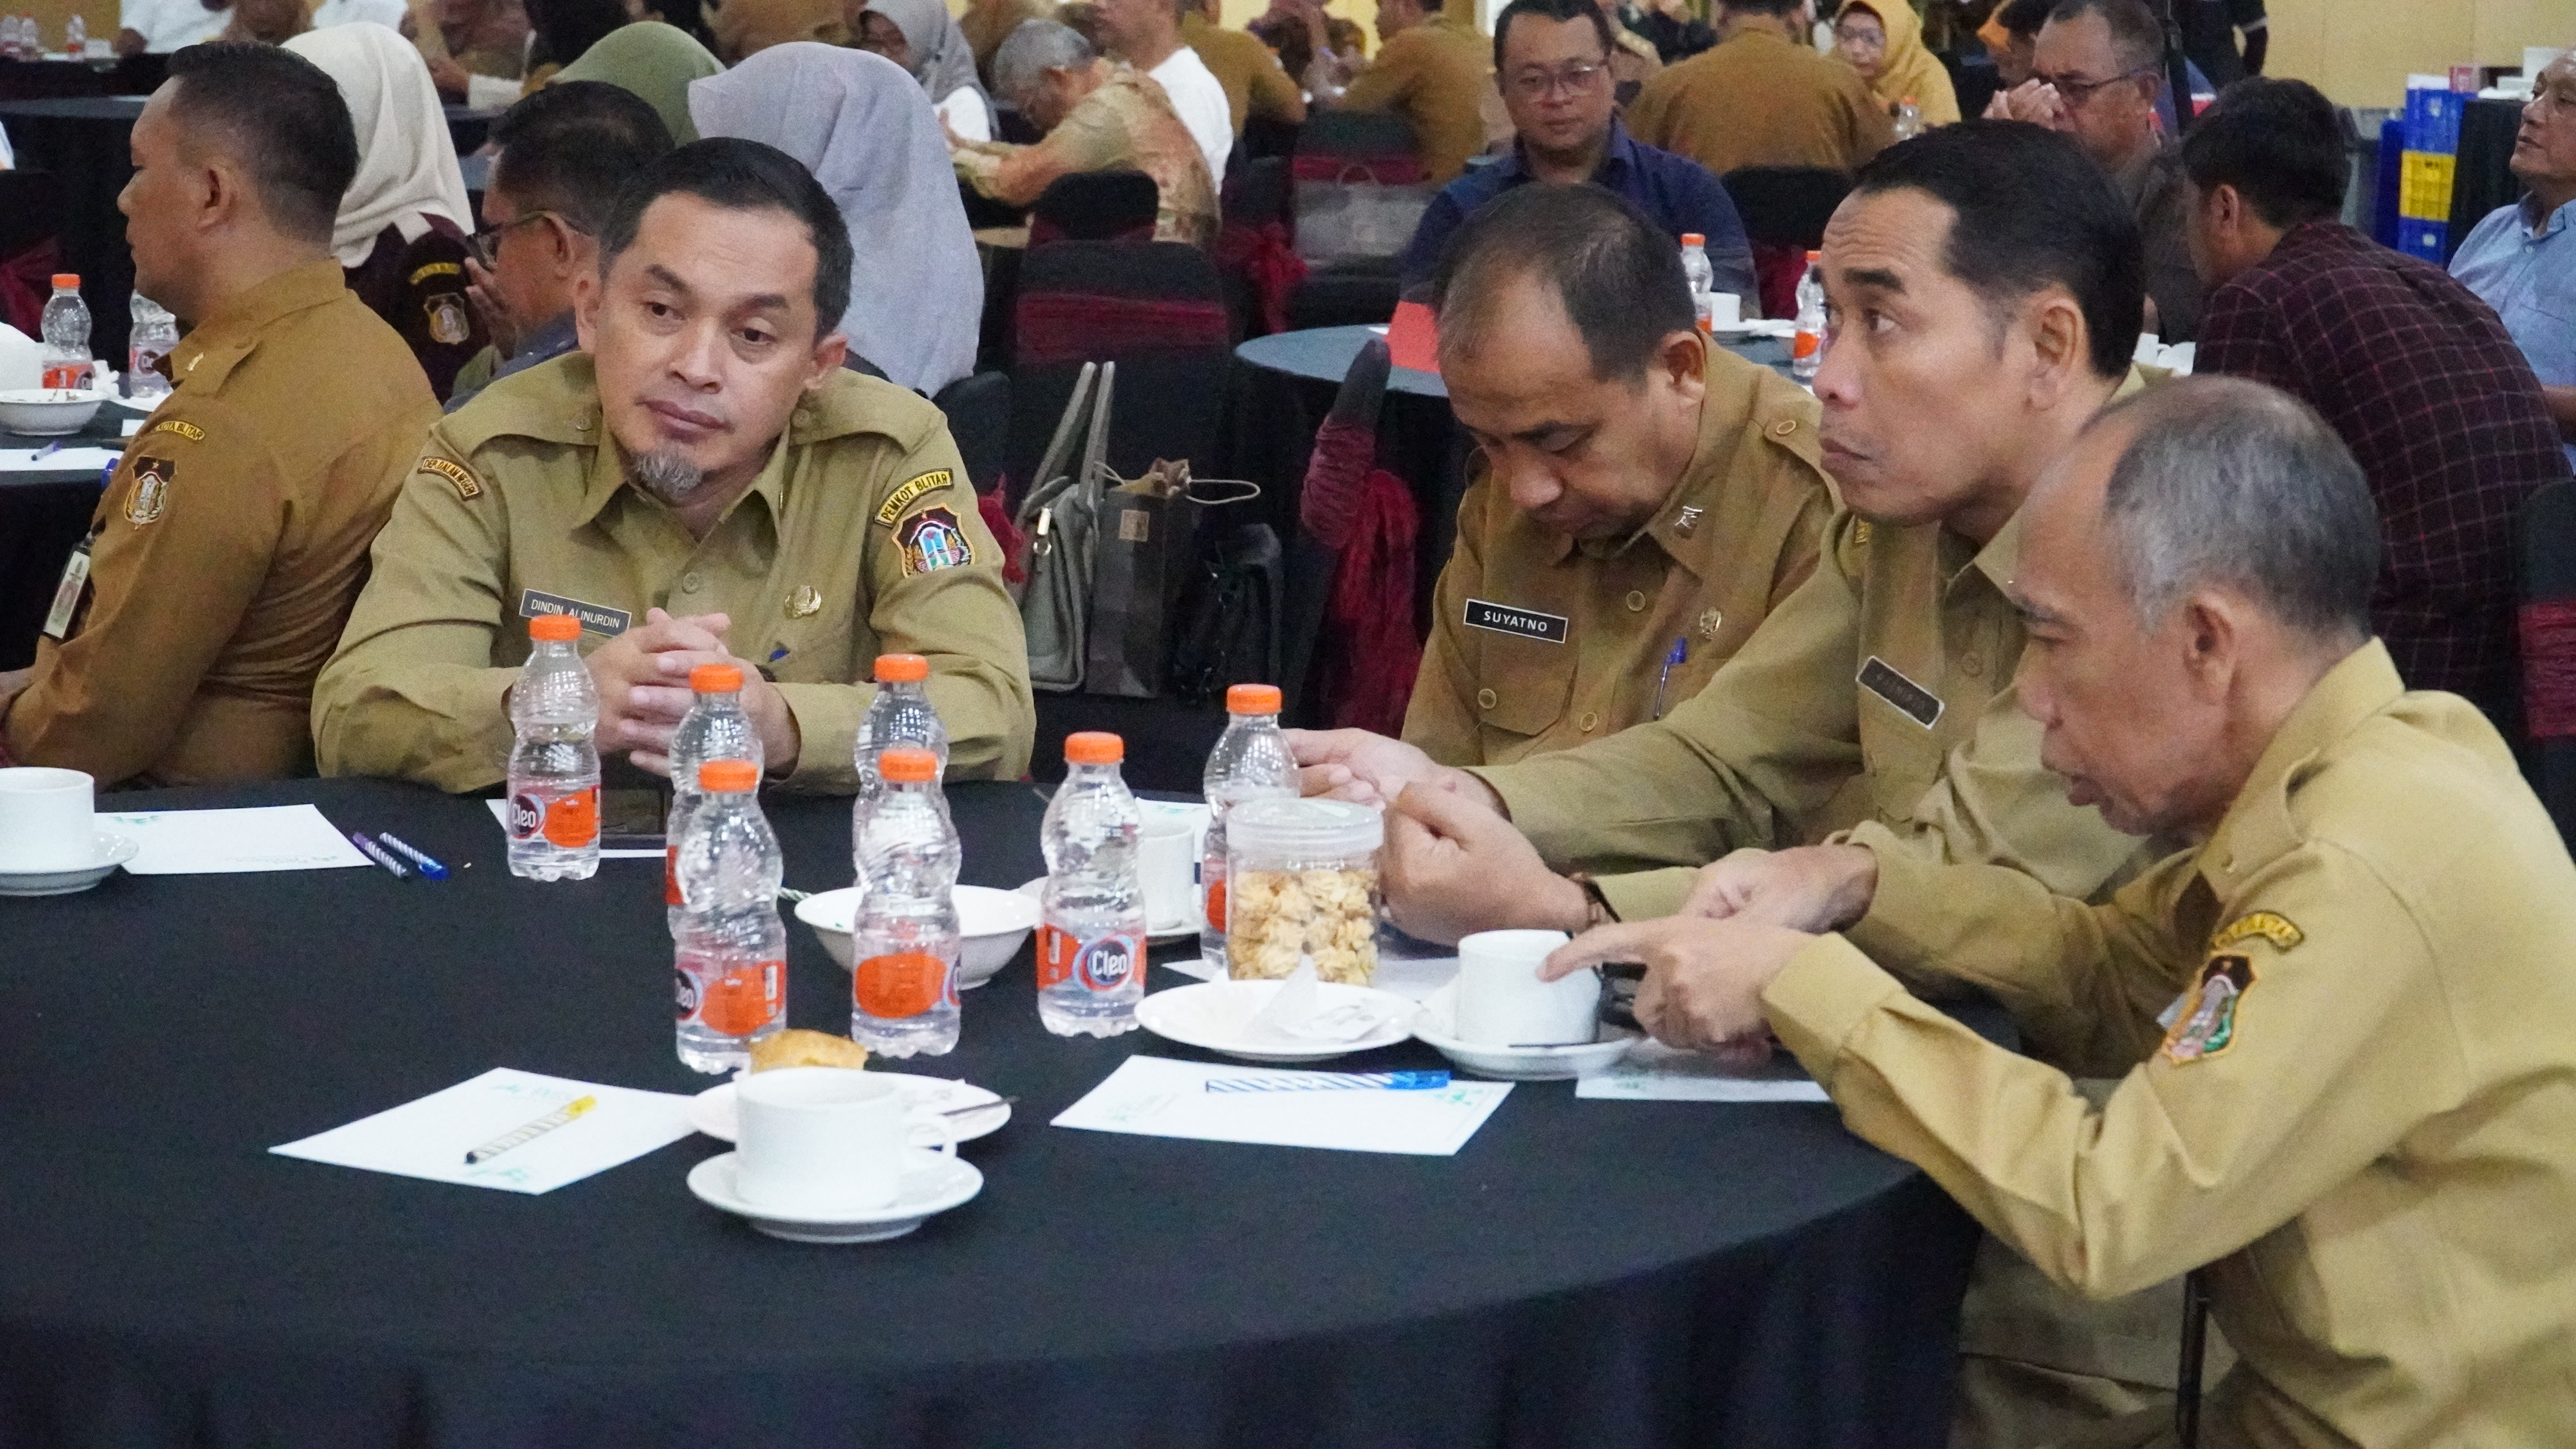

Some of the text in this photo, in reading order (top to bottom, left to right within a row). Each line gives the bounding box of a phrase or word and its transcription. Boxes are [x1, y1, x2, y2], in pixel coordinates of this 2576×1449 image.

[881, 473, 948, 521] PEMKOT BLITAR
[531, 599, 564, 615] DINDIN
[1483, 610, 1547, 632] SUYATNO
[1091, 950, 1127, 976] Cleo
